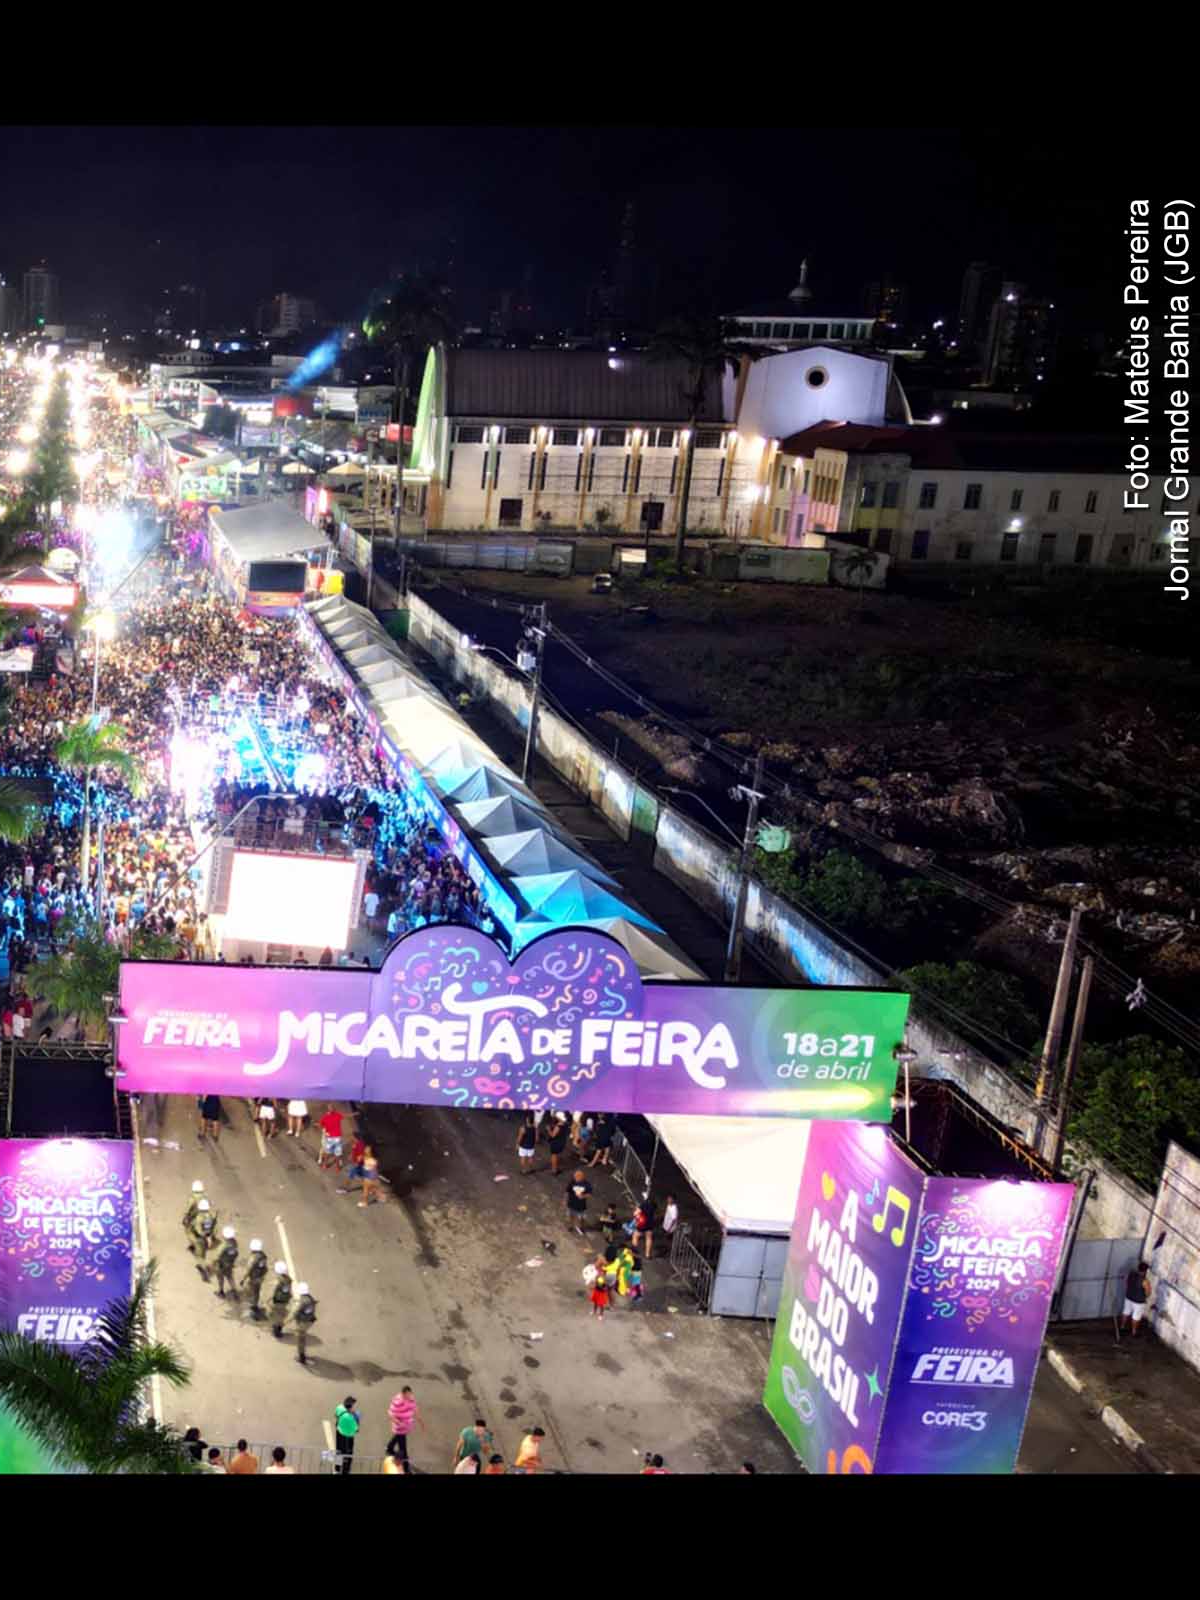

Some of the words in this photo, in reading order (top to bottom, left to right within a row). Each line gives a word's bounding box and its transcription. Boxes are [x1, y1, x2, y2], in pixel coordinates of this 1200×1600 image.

[143, 1017, 240, 1049] FEIRA
[531, 1027, 573, 1056] DE
[777, 1059, 809, 1078] de
[815, 1061, 872, 1080] abril
[23, 1217, 41, 1229] DE
[840, 1188, 858, 1243] A
[49, 1237, 82, 1249] 2024
[807, 1207, 879, 1325] MAIOR
[943, 1255, 961, 1268] DE
[965, 1278, 1000, 1291] 2024
[816, 1278, 849, 1347] DO
[789, 1299, 860, 1428] BRASIL
[911, 1354, 1015, 1385] FEIRA
[921, 1411, 988, 1431] CORE3
